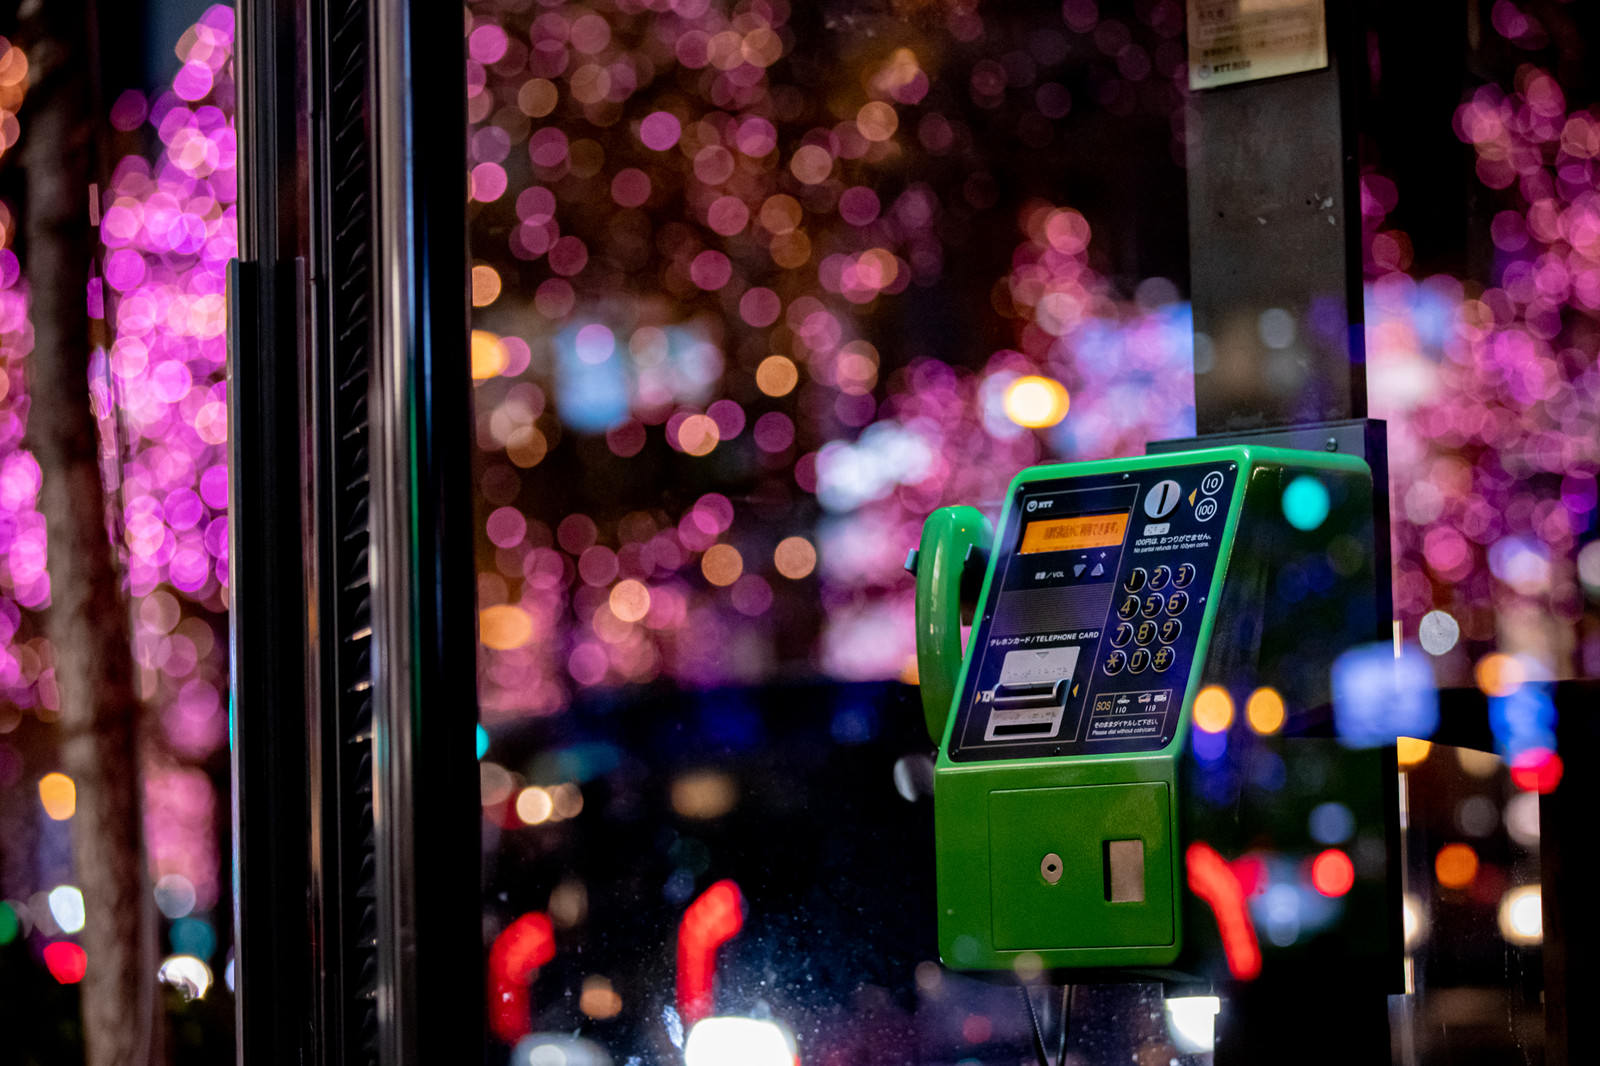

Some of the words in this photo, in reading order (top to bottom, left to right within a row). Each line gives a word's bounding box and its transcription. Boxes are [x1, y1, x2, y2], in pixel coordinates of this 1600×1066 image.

[1206, 478, 1218, 488] 10
[1198, 504, 1214, 516] 100
[1078, 631, 1099, 639] CARD
[1096, 701, 1111, 711] SOS
